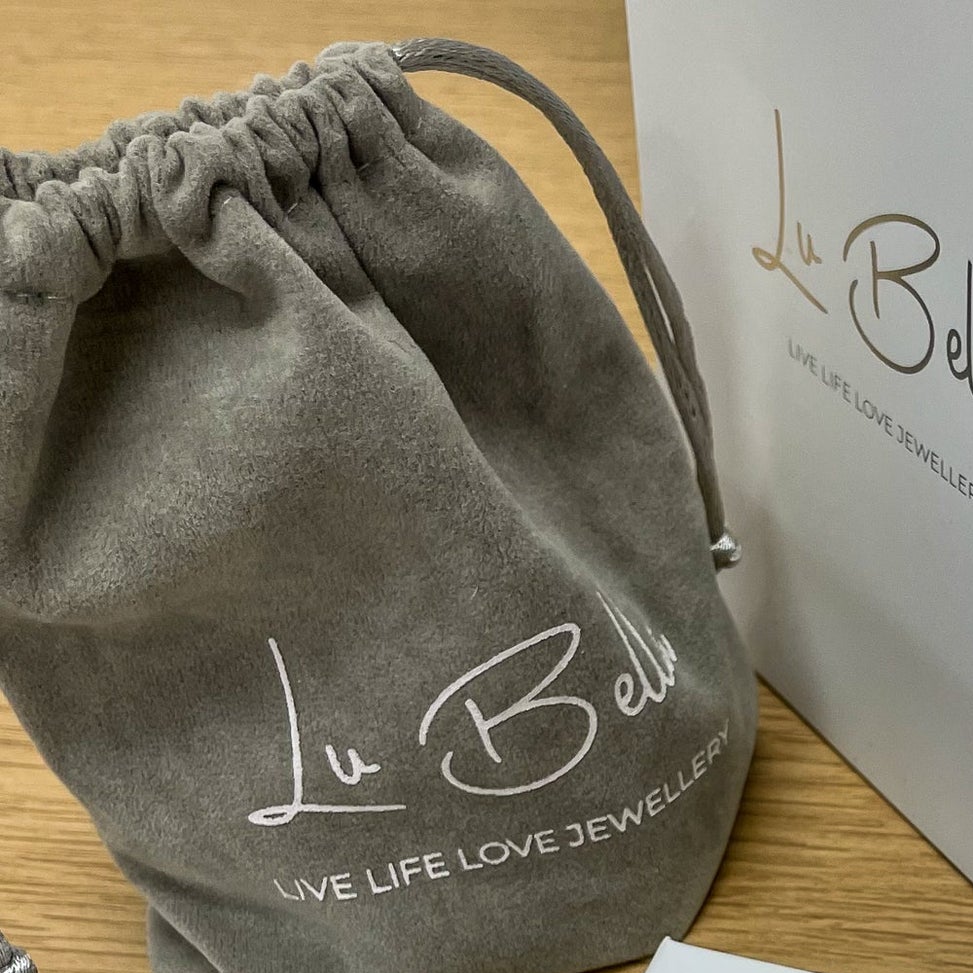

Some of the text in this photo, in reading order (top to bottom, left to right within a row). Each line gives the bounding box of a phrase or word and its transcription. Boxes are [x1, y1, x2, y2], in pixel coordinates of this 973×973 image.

[752, 108, 829, 315] Lu
[788, 336, 818, 377] LIVE
[821, 364, 851, 403] LIFE
[854, 391, 893, 437] LOVE
[247, 637, 407, 826] Lu
[273, 718, 730, 902] LIVE LIFE LOVE JEWELLERY
